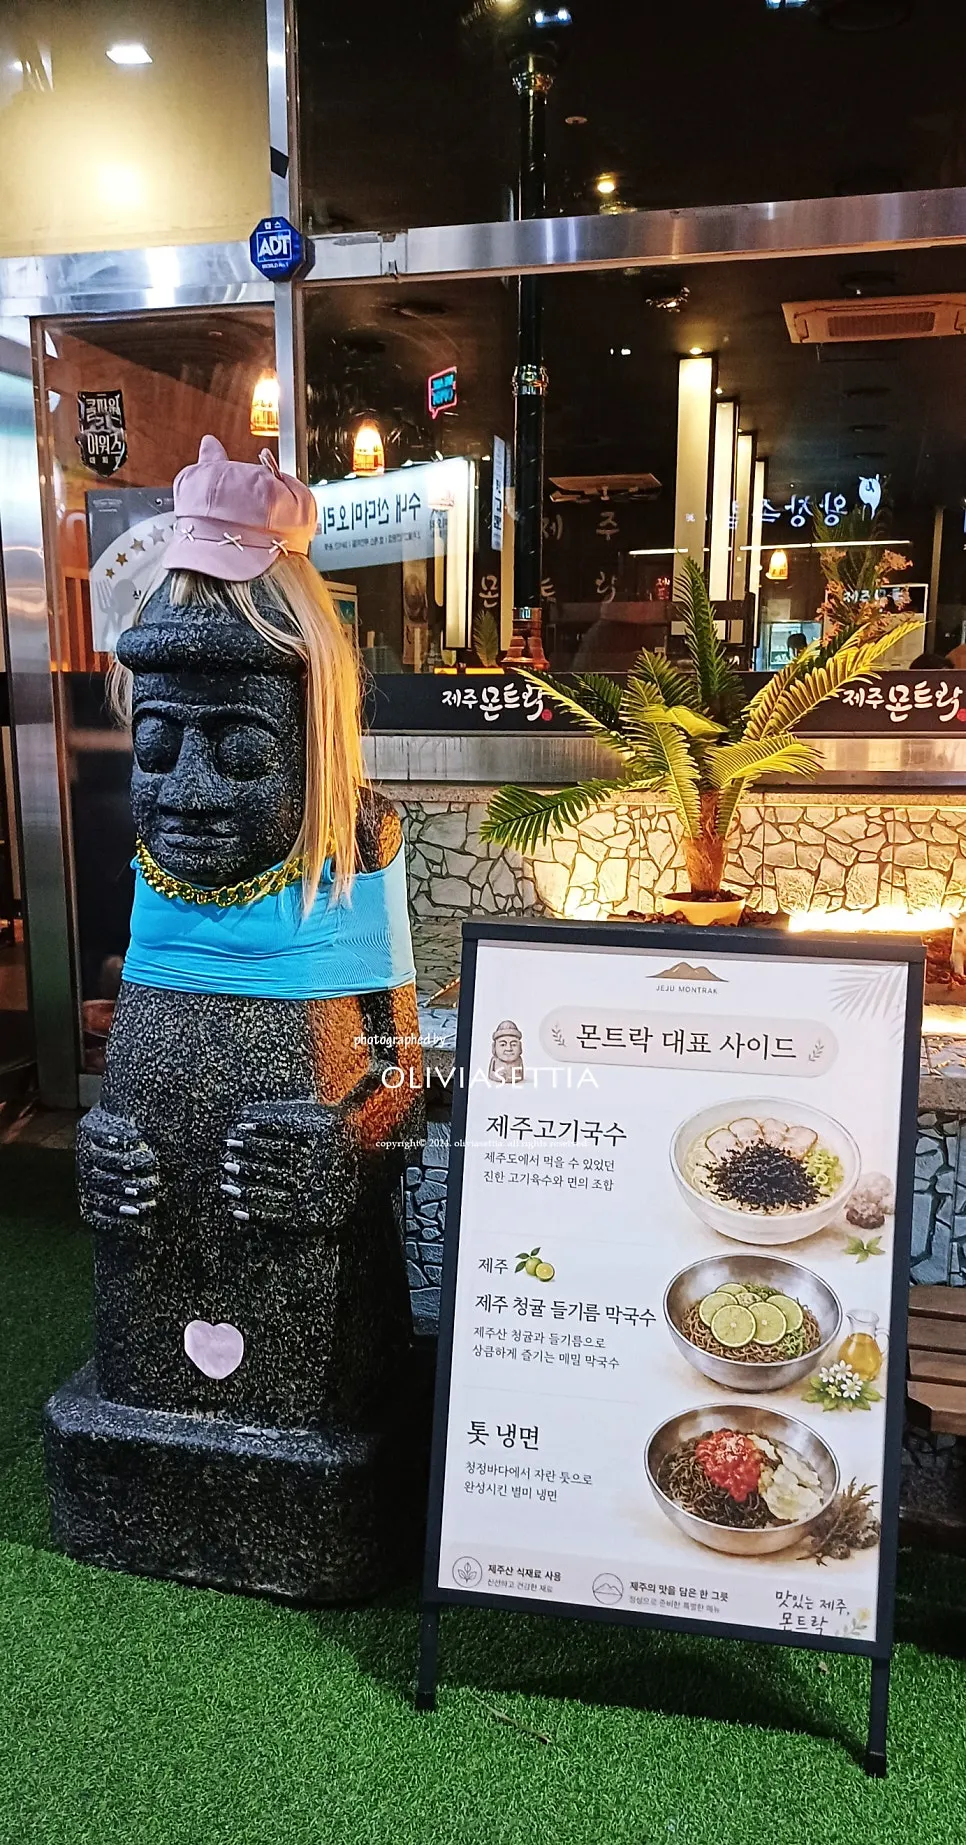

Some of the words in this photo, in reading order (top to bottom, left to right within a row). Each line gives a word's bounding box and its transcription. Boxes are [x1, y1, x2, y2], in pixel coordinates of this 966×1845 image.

[258, 235, 291, 257] ADT
[678, 986, 718, 994] MONTRAK
[576, 1024, 653, 1053] 몬트락
[662, 1029, 711, 1055] 대표
[719, 1032, 796, 1060] 사이드
[486, 1114, 627, 1147] 제주고기국수
[485, 1152, 540, 1166] 제주도에서
[544, 1156, 565, 1168] 먹을
[568, 1157, 579, 1169] 수
[484, 1170, 505, 1183] 진한
[508, 1173, 563, 1188] 고기육수와
[592, 1179, 614, 1191] 조합
[478, 1257, 508, 1274] 제주
[475, 1294, 508, 1314] 제주
[513, 1297, 546, 1317] 청귤
[551, 1300, 600, 1322] 들기름
[605, 1305, 657, 1327] 막국수
[473, 1326, 507, 1341] 제주산
[549, 1333, 606, 1348] 들기름으로
[472, 1344, 517, 1360] 상큼하게
[521, 1349, 555, 1363] 즐기는
[559, 1352, 580, 1366] 메밀
[585, 1355, 620, 1369] 막국수
[467, 1421, 489, 1445] 톳
[496, 1423, 539, 1450] 냉면
[466, 1461, 530, 1479] 청정바다에서
[535, 1469, 555, 1482] 자란
[560, 1471, 592, 1485] 톳으로
[464, 1481, 507, 1496] 완성시킨
[511, 1485, 532, 1499] 별미
[536, 1489, 557, 1502] 냉면
[488, 1564, 514, 1576] 제주산
[517, 1567, 541, 1579] 식재료
[545, 1571, 561, 1582] 사용
[630, 1581, 656, 1593] 제주의
[659, 1584, 676, 1596] 맛을
[680, 1587, 696, 1598] 담은
[700, 1589, 708, 1600] 한
[712, 1591, 729, 1602] 그릇
[775, 1590, 814, 1610] 맛있는
[820, 1598, 850, 1616] 제주,
[779, 1612, 829, 1636] 몬트락
